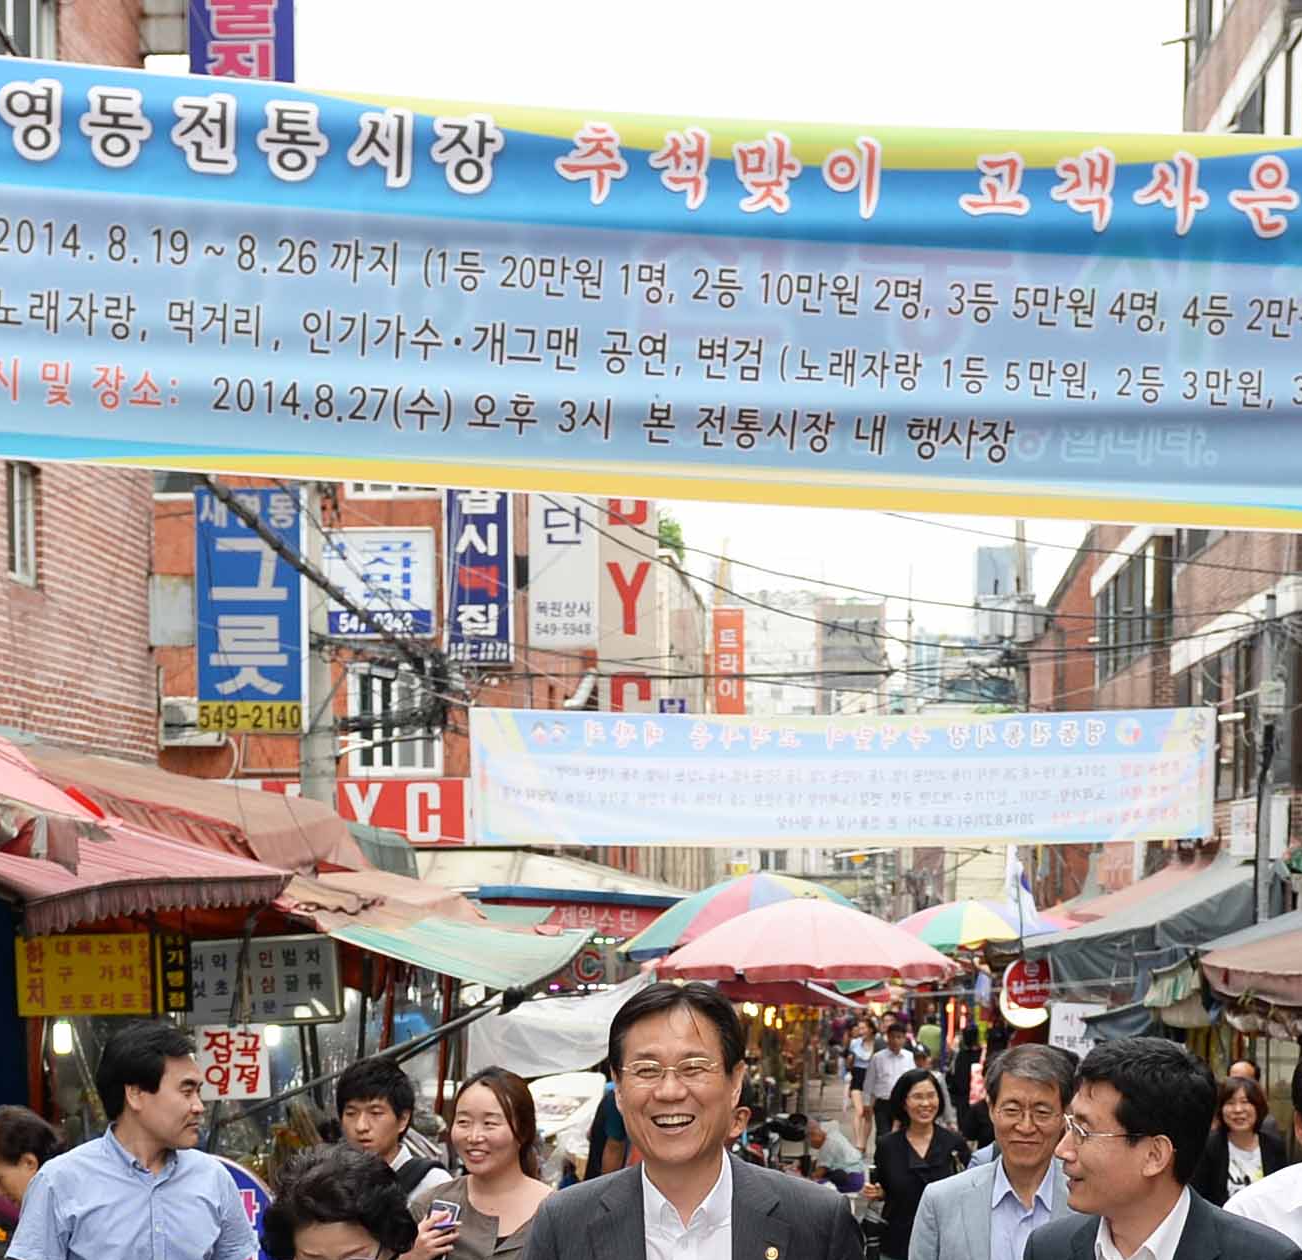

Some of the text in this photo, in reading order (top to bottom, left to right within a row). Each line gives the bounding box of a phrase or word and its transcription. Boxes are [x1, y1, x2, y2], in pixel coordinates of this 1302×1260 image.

[5, 87, 494, 188] 영동전통시장
[560, 125, 879, 214] 추석맞이
[964, 151, 1296, 236] 고객사은
[330, 239, 398, 286] 까지
[423, 247, 486, 292] (1등
[500, 255, 603, 300] 20만원
[620, 263, 675, 305] 1명,
[691, 268, 744, 309] 2등
[760, 272, 860, 316] 10만원
[873, 278, 931, 320] 2명,
[947, 283, 999, 324] 3등
[1012, 286, 1096, 329] 5만원
[1108, 290, 1165, 333] 4명,
[1182, 295, 1234, 336] 4등
[168, 300, 280, 352] 먹거리,
[599, 330, 682, 377] 공연,
[697, 336, 763, 382] 변검
[780, 345, 923, 392] (노래자랑
[942, 356, 989, 395] 1등
[1005, 359, 1097, 401] 5만원,
[1116, 366, 1165, 404] 2등
[1182, 368, 1273, 410] 3만원,
[42, 364, 70, 404] 및
[93, 366, 179, 410] 장소:
[212, 376, 452, 433] 2014.8.27(수)
[466, 393, 538, 436] 오후
[557, 398, 612, 441] 3시
[642, 402, 676, 444] 본
[695, 405, 836, 454] 전통시장
[854, 414, 887, 456] 내
[905, 416, 1016, 464] 행사장
[209, 537, 289, 695] 그릇
[200, 702, 299, 729] 549-2140
[203, 1031, 260, 1063] 잡곡
